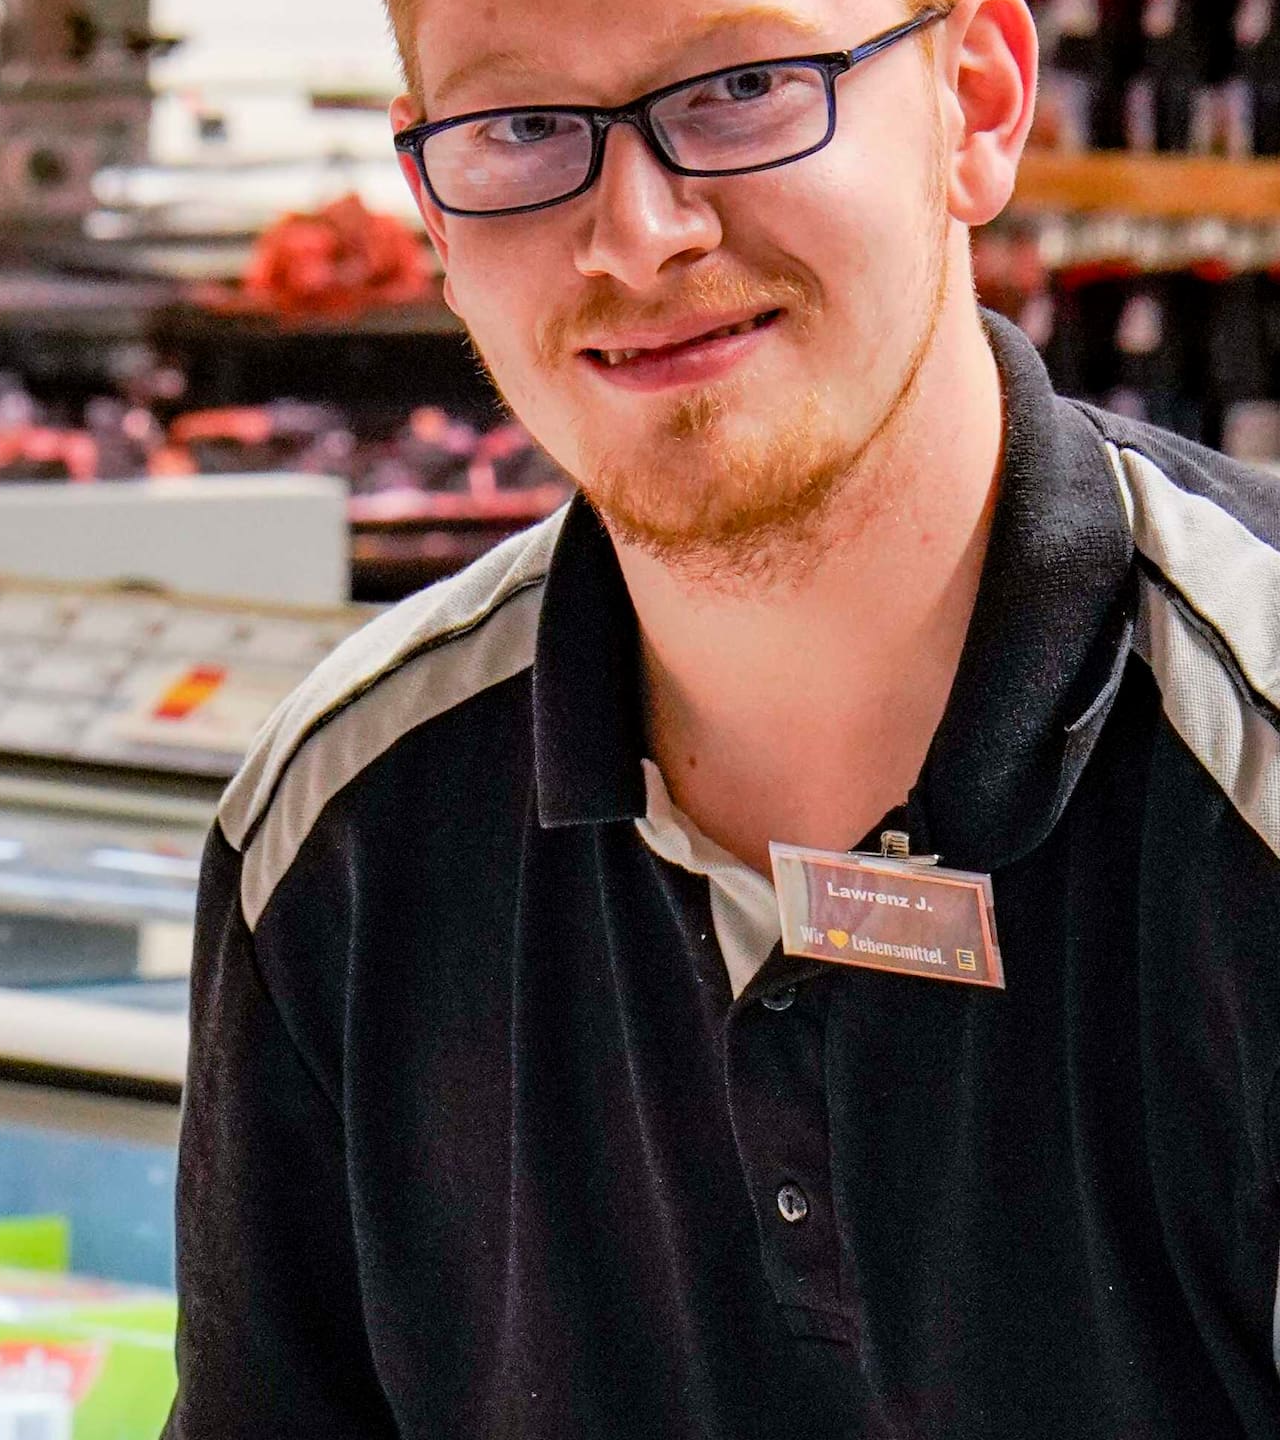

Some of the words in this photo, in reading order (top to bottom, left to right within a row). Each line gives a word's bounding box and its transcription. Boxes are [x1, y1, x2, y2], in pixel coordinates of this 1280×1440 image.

[827, 881, 910, 909] Lawrenz
[915, 896, 933, 912] J.
[800, 925, 825, 946] Wir
[851, 934, 948, 966] Lebensmittel.
